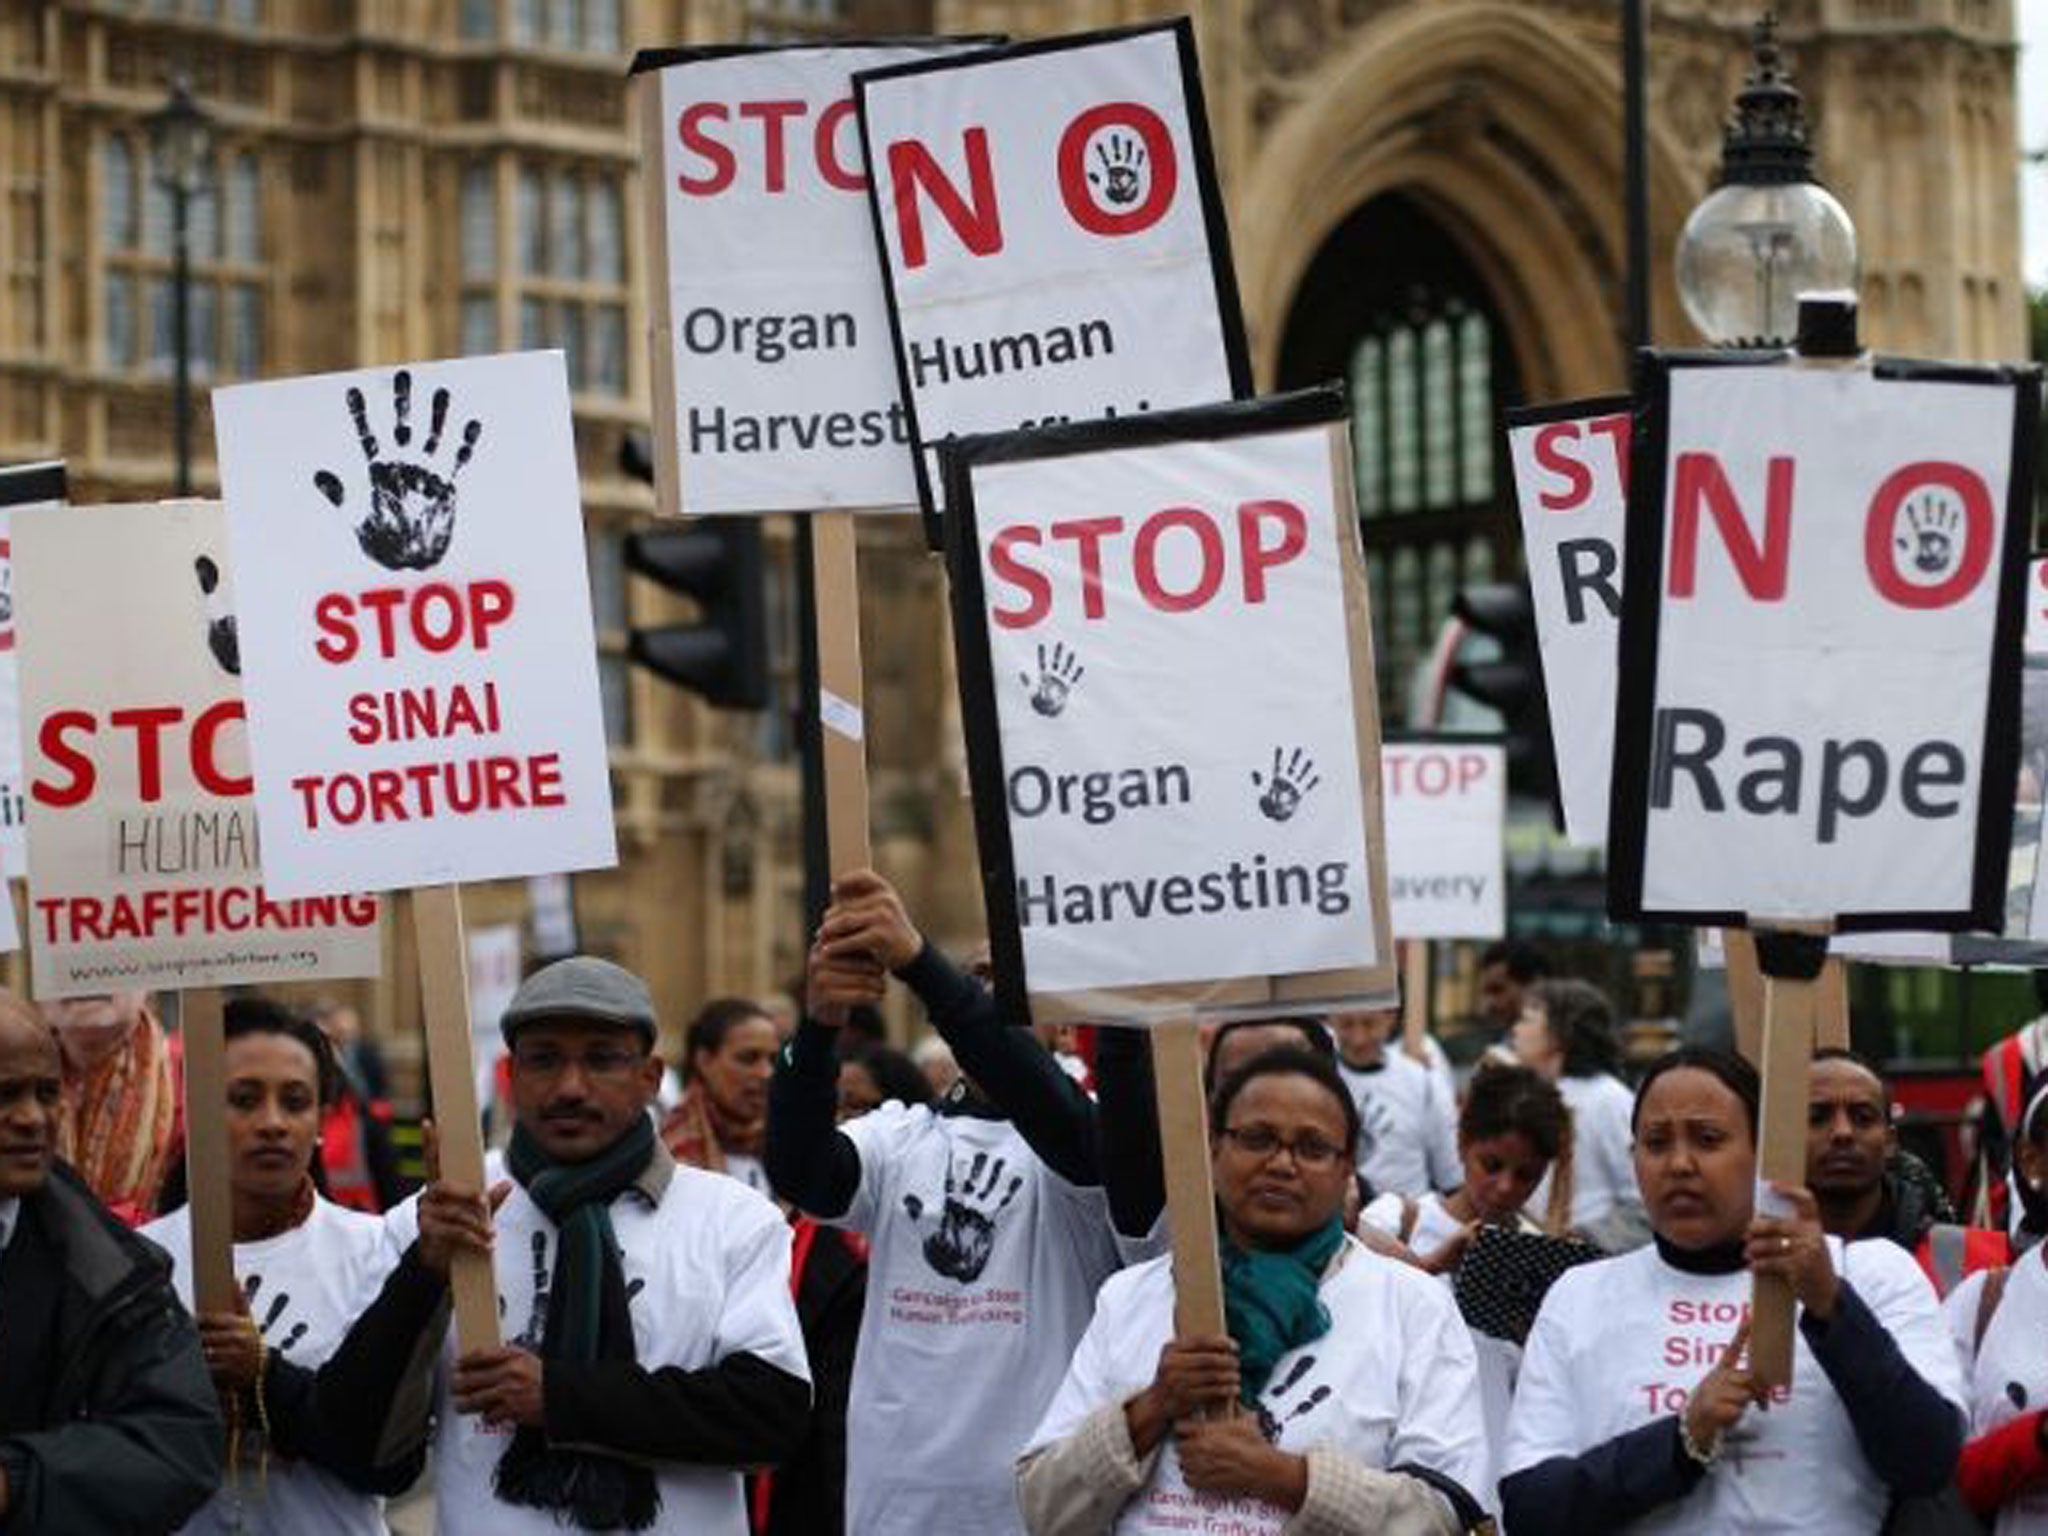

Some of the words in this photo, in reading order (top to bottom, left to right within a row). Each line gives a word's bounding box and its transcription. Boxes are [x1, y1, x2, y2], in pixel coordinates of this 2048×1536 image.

[684, 308, 857, 363] Organ
[911, 318, 1115, 388] Human
[989, 500, 1309, 630] STOP
[315, 577, 517, 665] STOP
[347, 683, 502, 746] SINAI
[292, 752, 567, 831] TORTURE
[1006, 764, 1192, 826] Organ
[1649, 706, 1967, 844] Rape
[36, 884, 382, 945] TRAFFICKING
[1017, 855, 1351, 929] Harvesting
[1669, 1300, 1750, 1325] Sto
